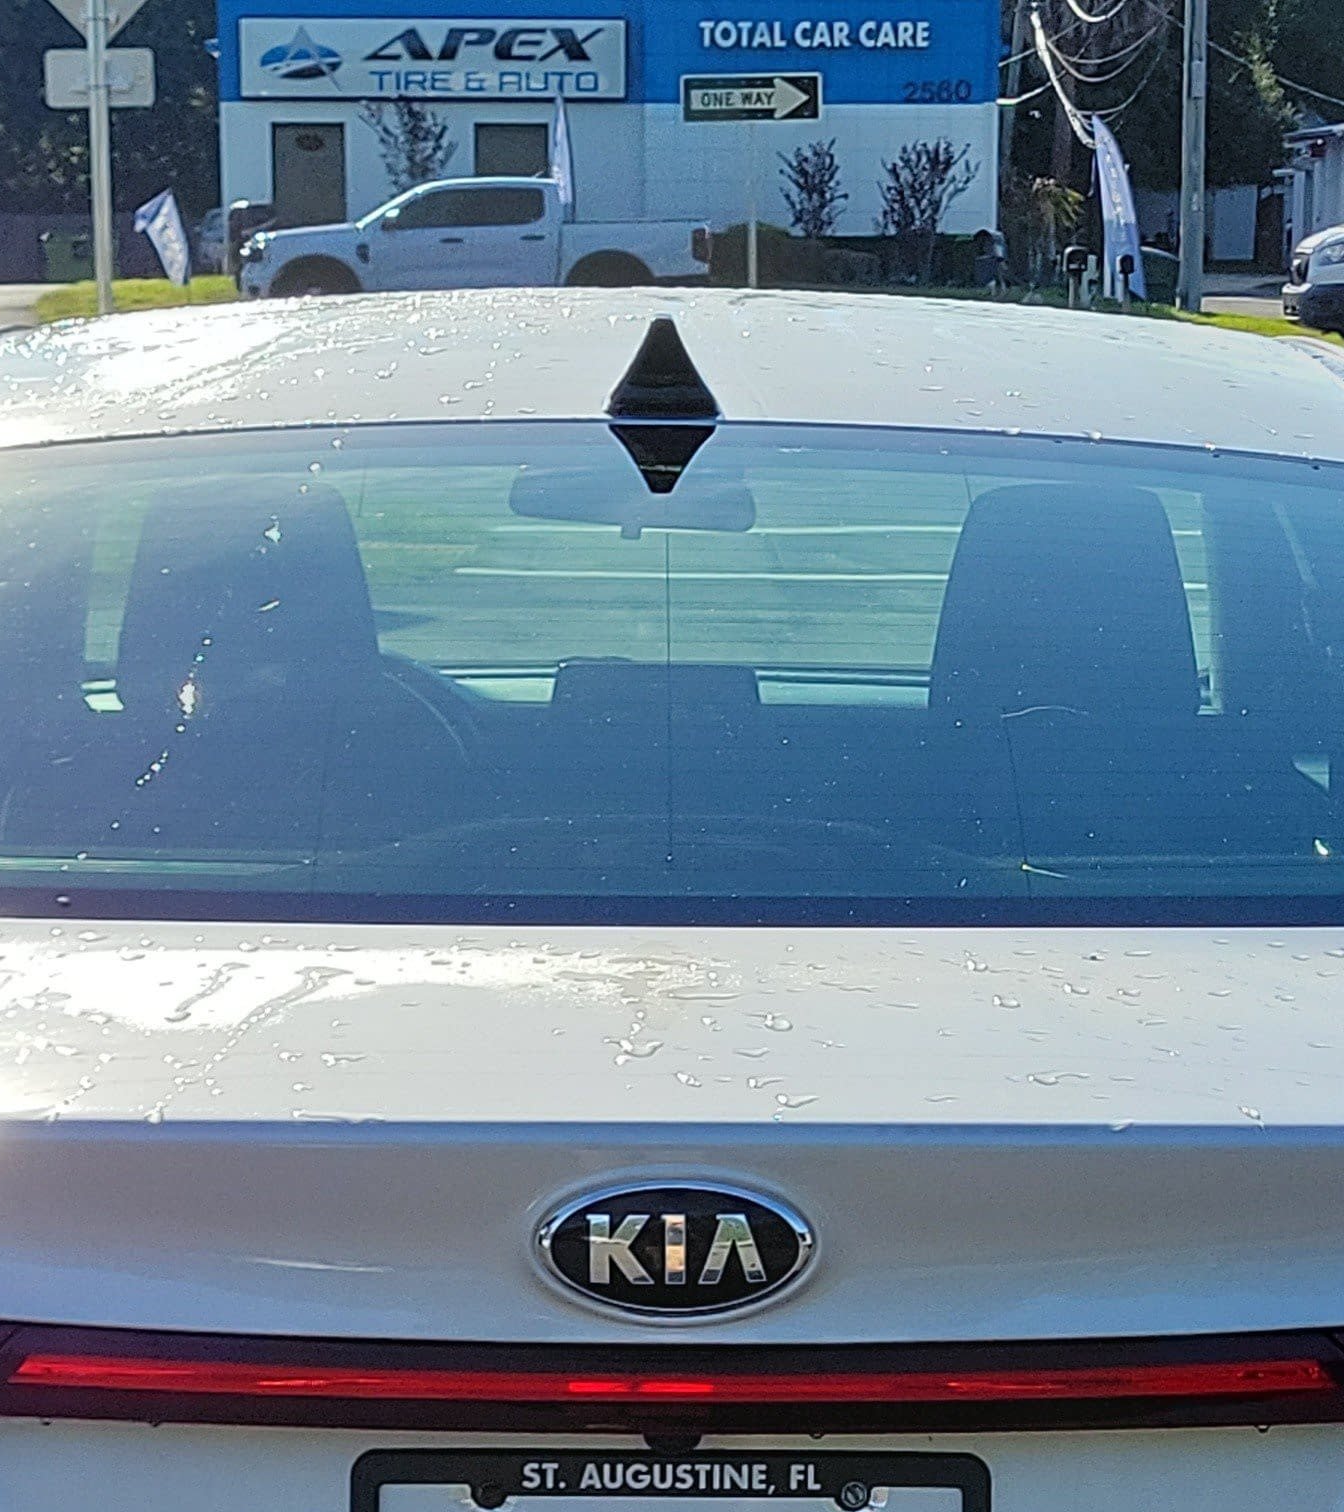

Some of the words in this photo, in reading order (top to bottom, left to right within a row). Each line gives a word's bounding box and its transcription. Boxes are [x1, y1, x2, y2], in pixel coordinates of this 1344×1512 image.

[362, 27, 605, 62] APEX
[699, 20, 787, 48] TOTAL
[794, 20, 851, 48] CAR
[859, 20, 931, 48] CARE
[369, 71, 454, 92] TIRE
[464, 71, 487, 92] &
[499, 71, 599, 93] AUTO
[700, 91, 736, 107] ONE
[740, 90, 775, 106] WAY
[585, 1213, 767, 1285] KIA
[522, 1463, 567, 1490] ST.
[580, 1463, 775, 1493] AUGUSTINE,
[789, 1464, 822, 1491] FL
